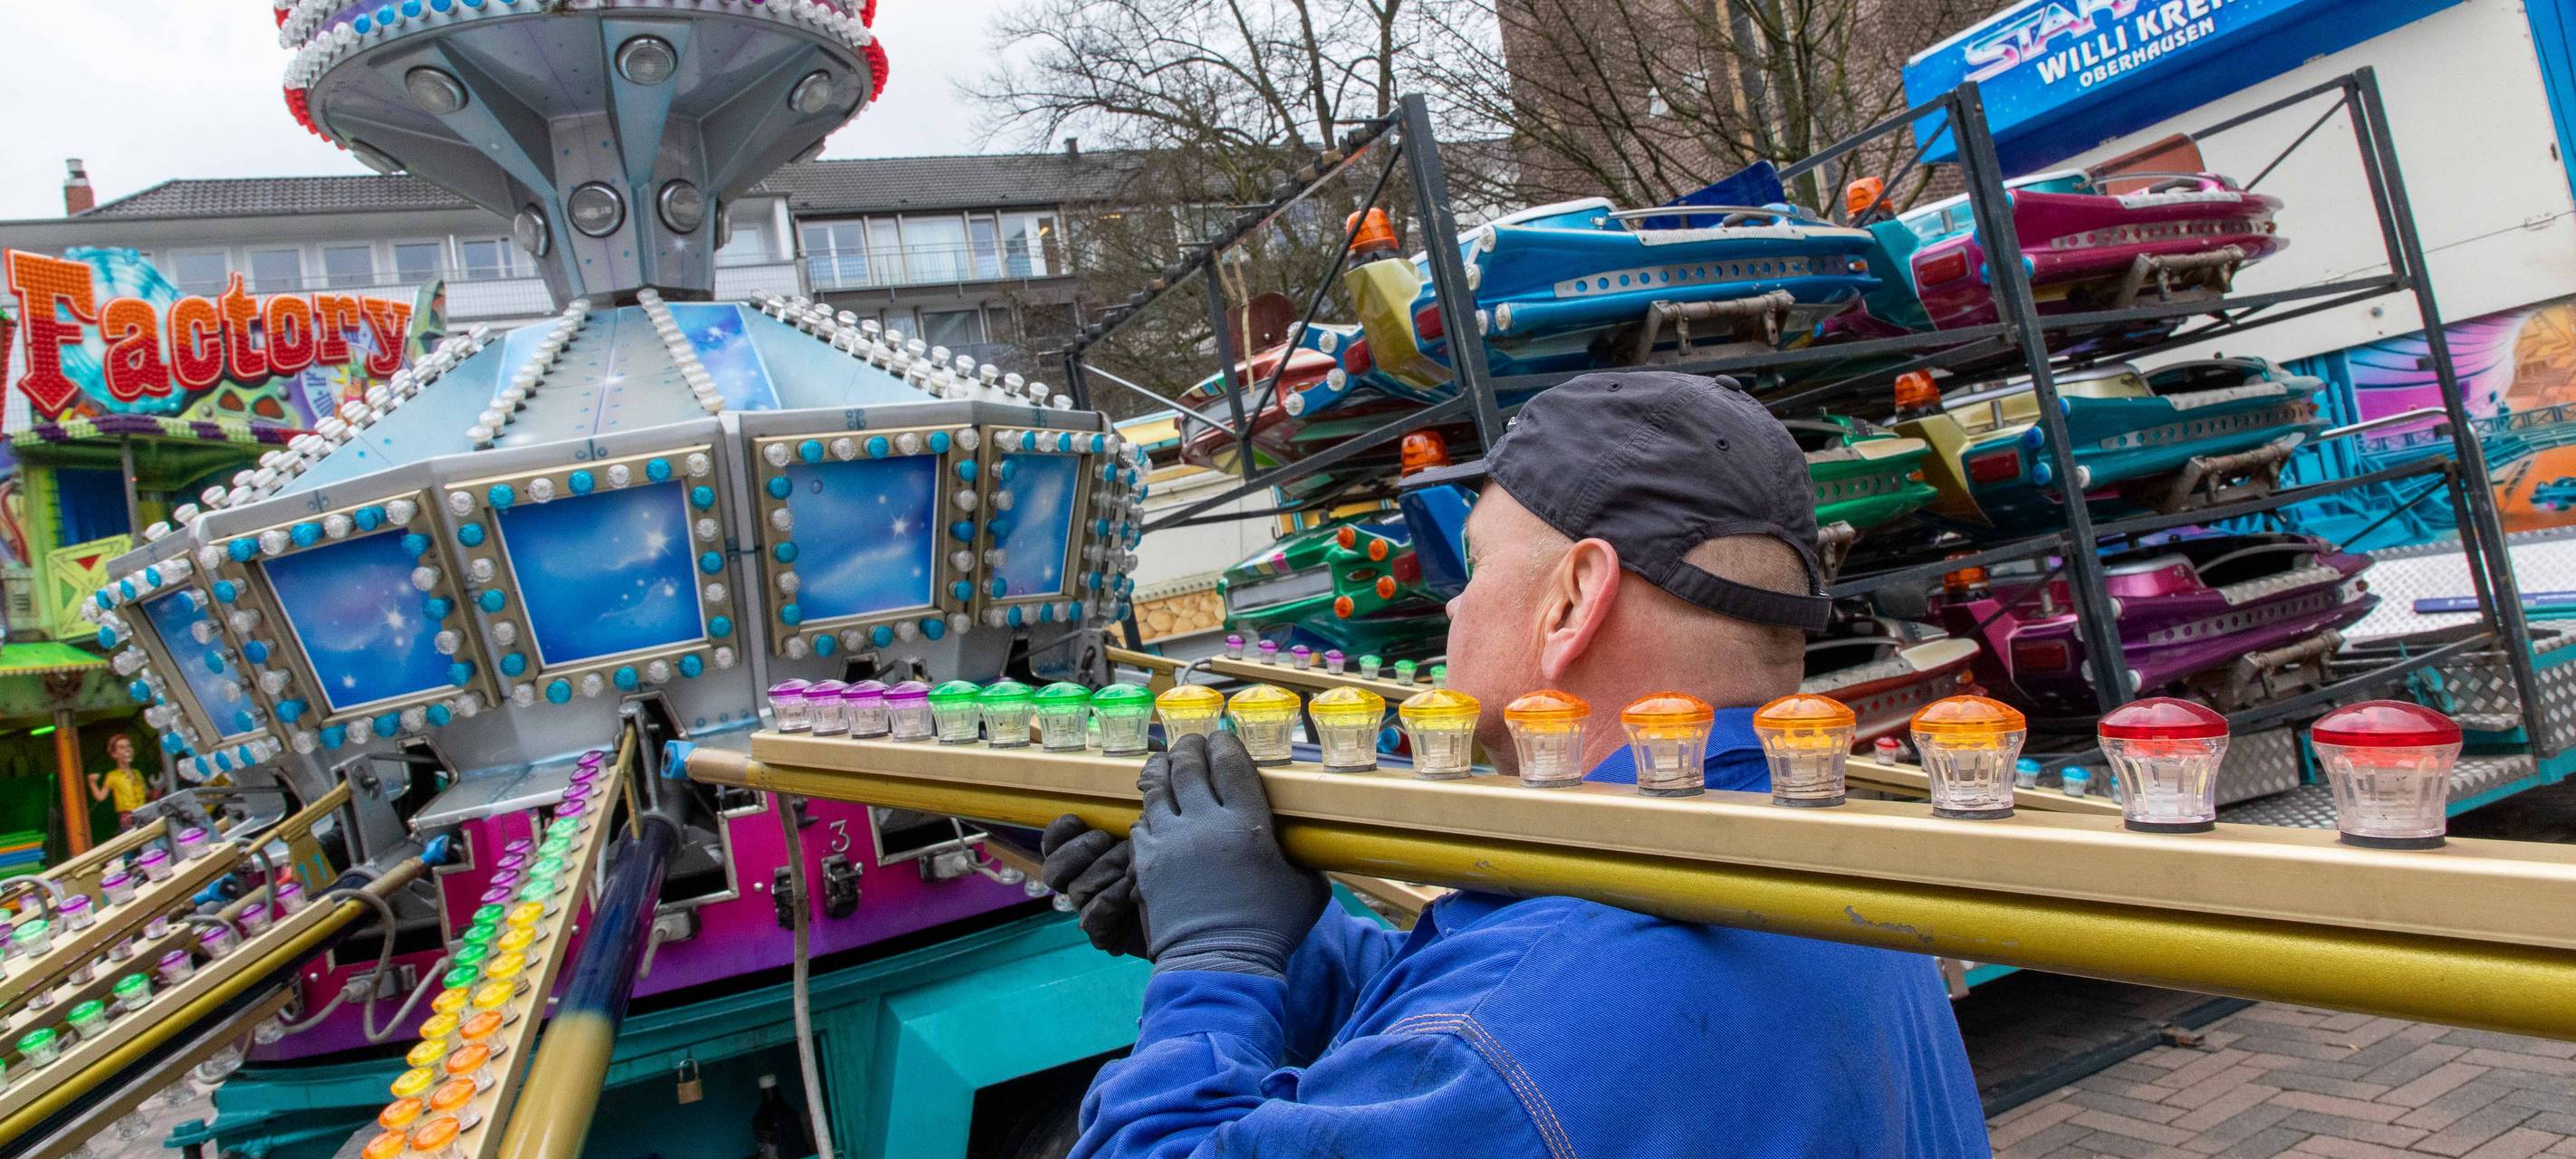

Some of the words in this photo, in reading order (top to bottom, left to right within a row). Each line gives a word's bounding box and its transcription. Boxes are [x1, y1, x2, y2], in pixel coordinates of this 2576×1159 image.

[2037, 24, 2128, 85] WILLI
[2136, 0, 2235, 43] KRE
[2079, 16, 2216, 88] OBERHAUSEN
[4, 248, 413, 420] Factory
[829, 819, 851, 852] 3
